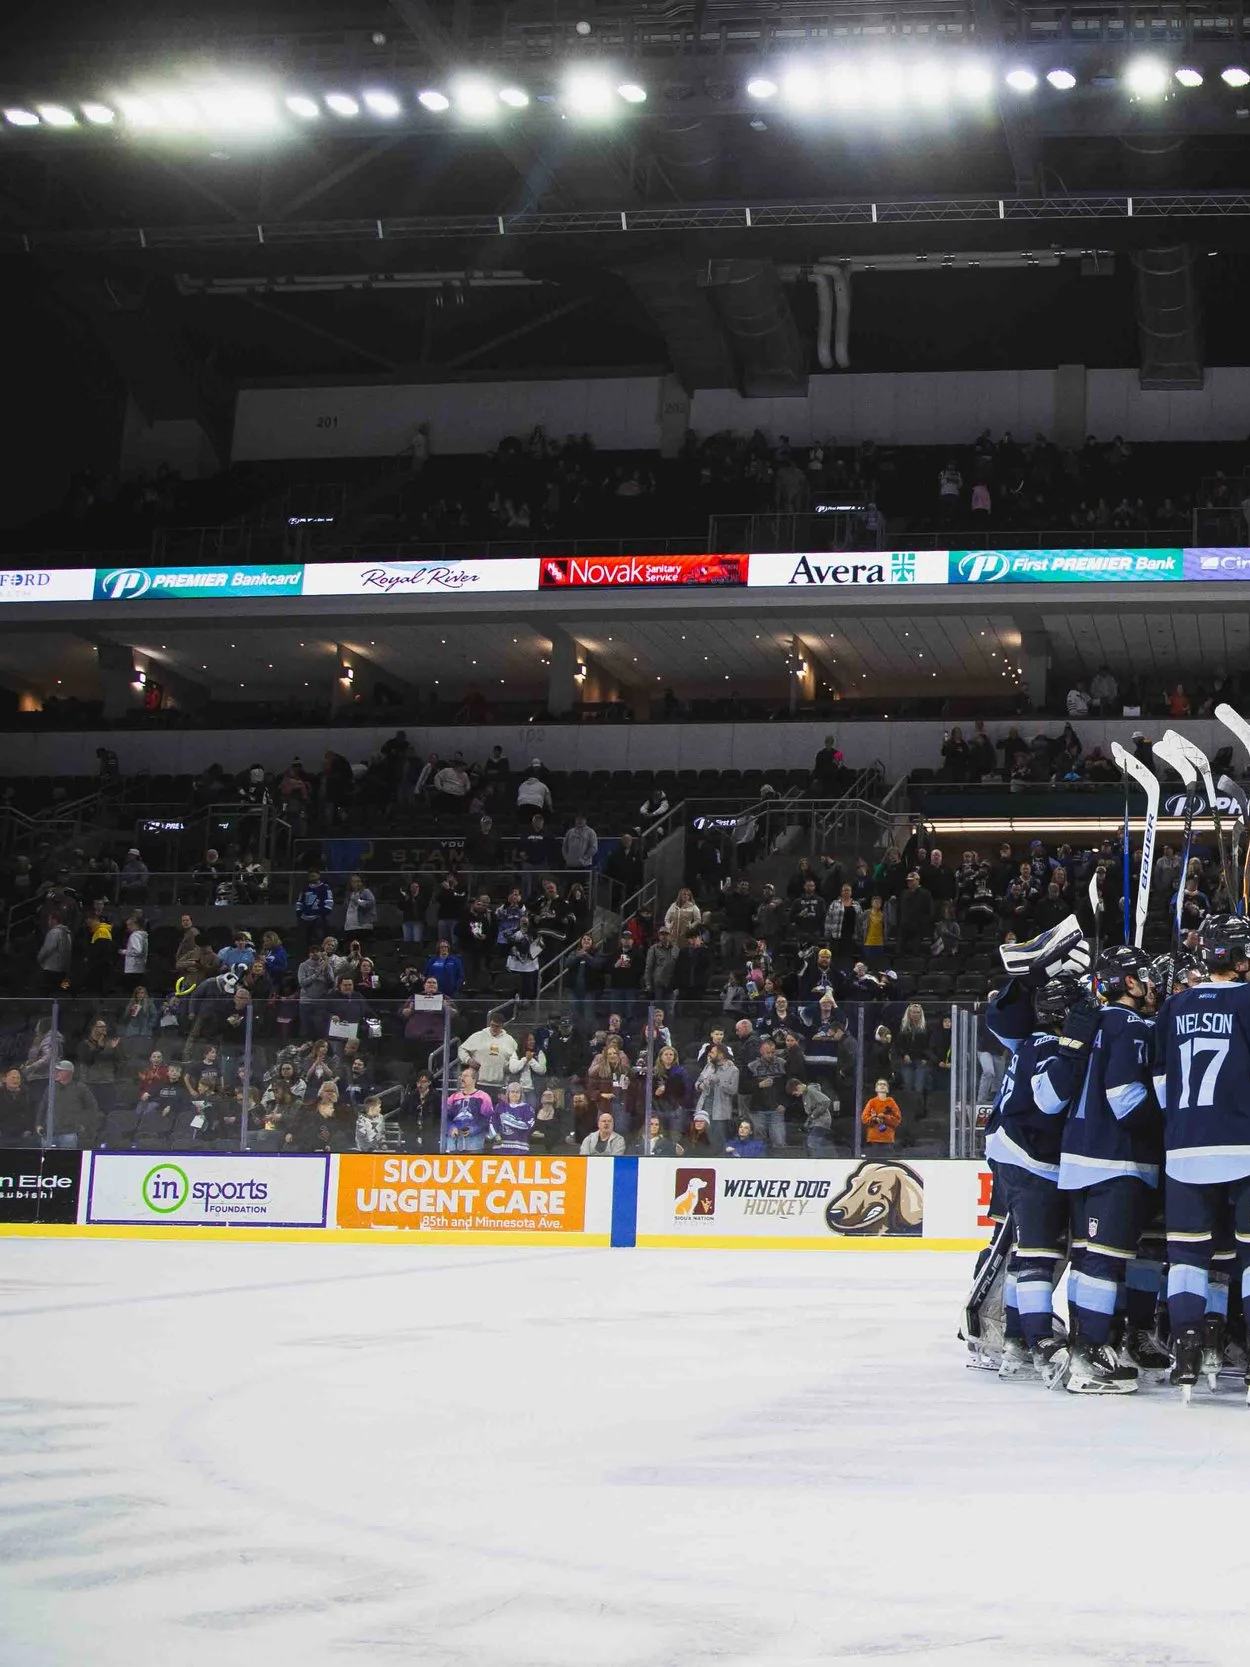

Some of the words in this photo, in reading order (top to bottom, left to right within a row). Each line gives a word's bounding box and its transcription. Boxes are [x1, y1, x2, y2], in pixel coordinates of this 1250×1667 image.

[315, 416, 339, 428] 201
[569, 559, 645, 585] Novak
[645, 563, 682, 576] Sanitary
[788, 556, 885, 584] Avera
[1012, 557, 1048, 571] First
[1050, 557, 1132, 571] PREMIER
[1135, 556, 1175, 570] Bank
[152, 573, 228, 588] PREMIER
[231, 571, 301, 586] Bankcard
[361, 567, 423, 592] Royal
[428, 567, 480, 590] River
[645, 572, 679, 582] Service
[518, 729, 545, 743] 102
[1141, 813, 1155, 890] BAUER
[1176, 1013, 1233, 1035] NELSON
[1178, 1038, 1230, 1109] 17
[19, 1174, 72, 1188] Eide
[384, 1159, 474, 1184] SIOUX
[482, 1160, 567, 1185] FALLS
[152, 1174, 179, 1199] in
[193, 1178, 268, 1212] sports
[725, 1180, 790, 1198] WIENER
[794, 1181, 831, 1198] DOG
[209, 1205, 267, 1213] FOUNDATION
[356, 1189, 479, 1213] URGENT
[485, 1190, 565, 1214] CARE
[744, 1199, 808, 1216] HOCKEY
[423, 1216, 448, 1228] 85th
[451, 1216, 472, 1228] and
[475, 1216, 536, 1228] Minnesota
[538, 1217, 563, 1228] Ave.
[973, 1253, 1004, 1305] TRUE
